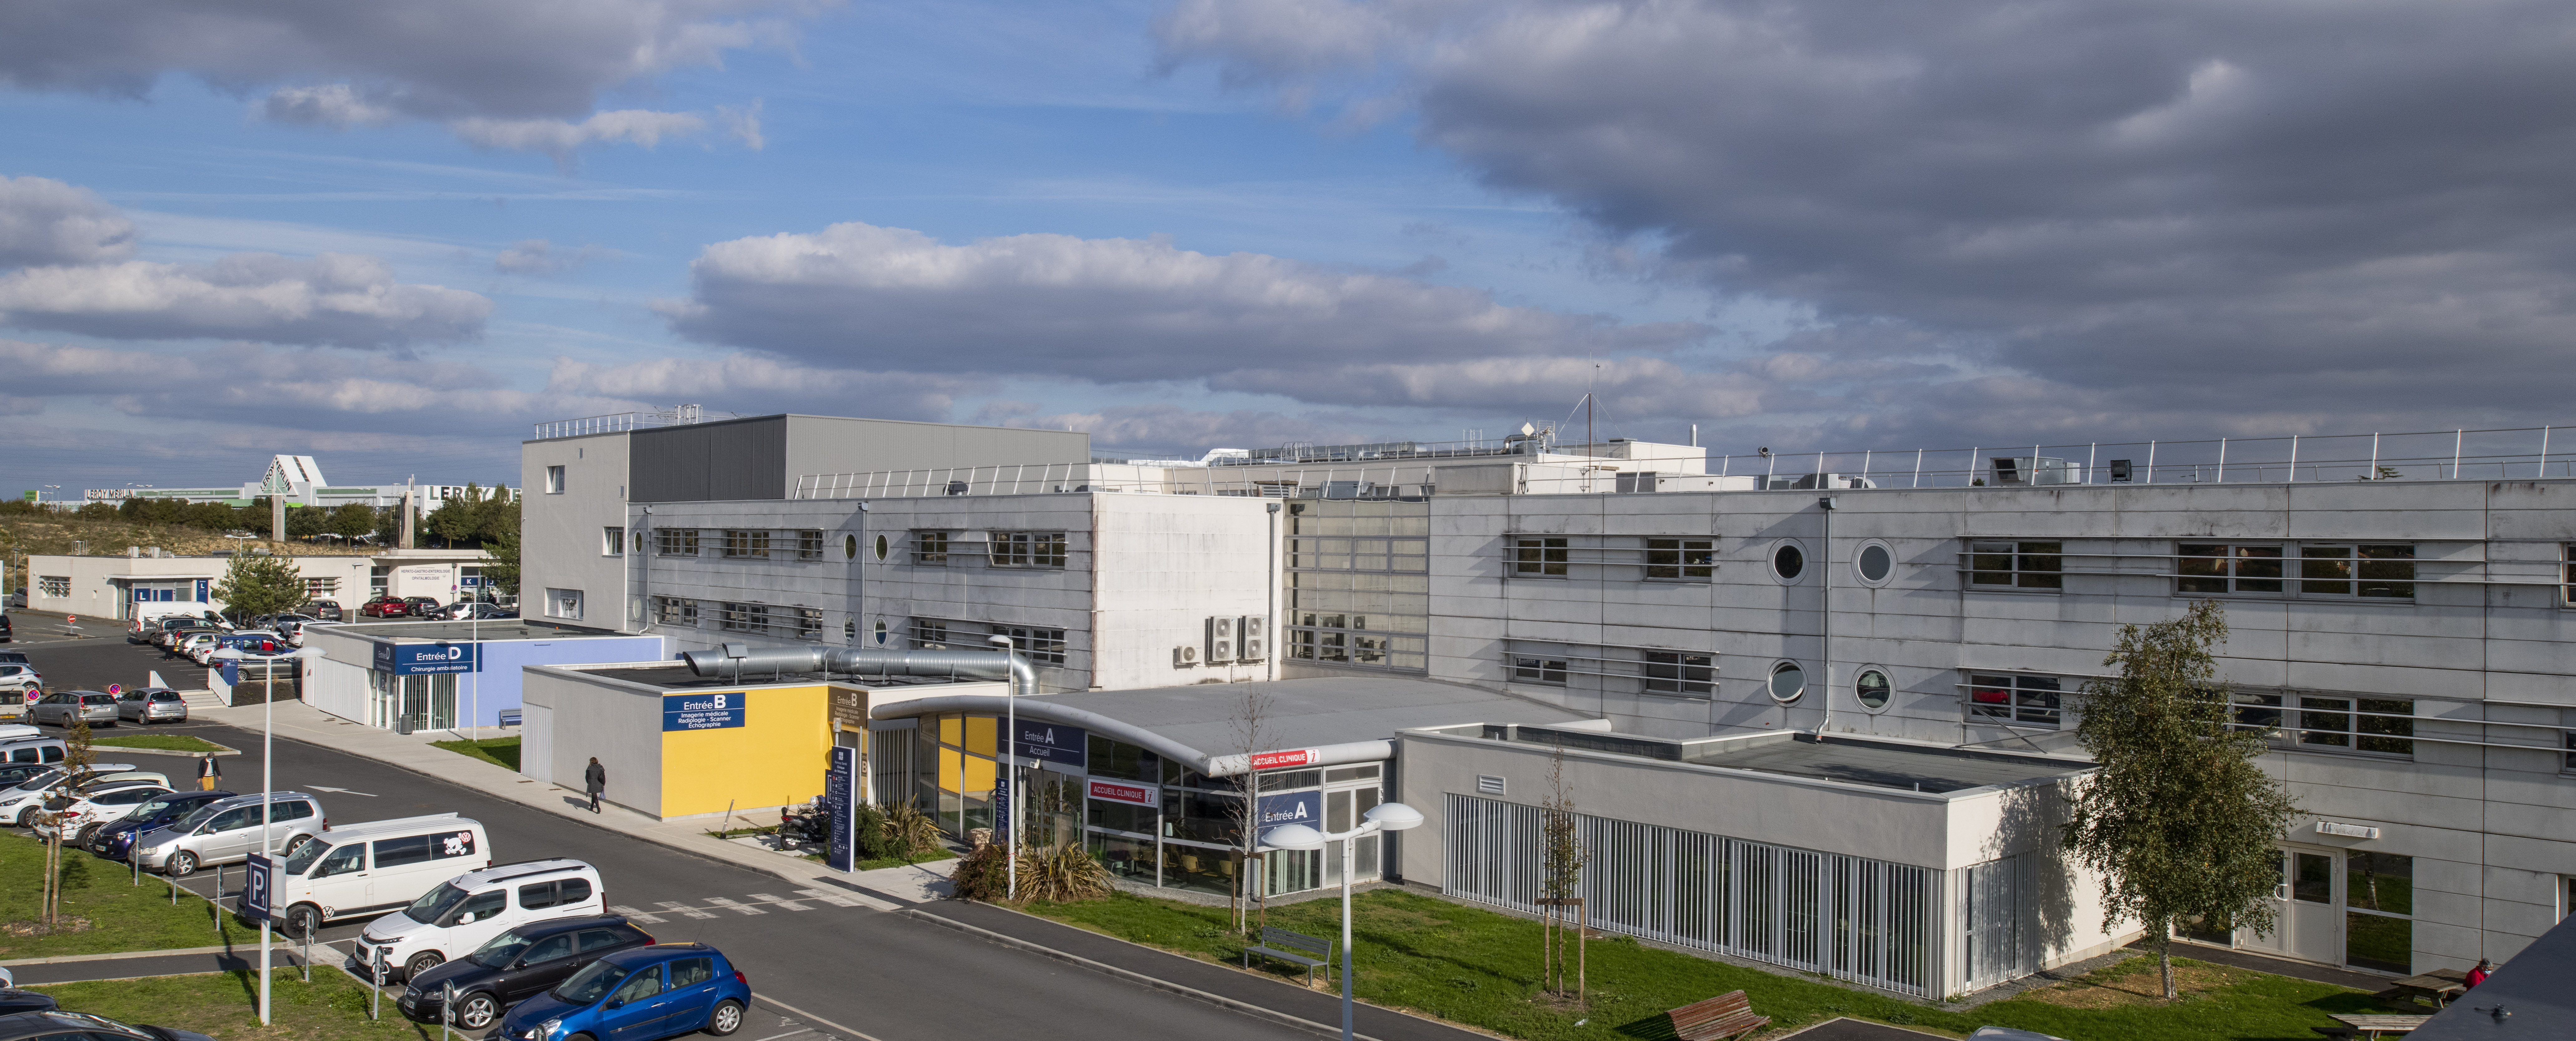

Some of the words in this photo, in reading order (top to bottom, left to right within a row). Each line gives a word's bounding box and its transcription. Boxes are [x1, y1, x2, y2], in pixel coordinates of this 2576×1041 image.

[87, 489, 107, 499] LEROY
[109, 489, 133, 499] MERLIN
[139, 592, 146, 600] L
[386, 647, 390, 660] D
[417, 652, 446, 660] Entrée
[448, 647, 461, 659] D
[684, 701, 713, 710] Entrée
[714, 695, 726, 708] B
[838, 696, 851, 705] Entrée
[852, 693, 857, 707] B
[1025, 731, 1044, 742] Entrée
[1045, 728, 1054, 744] A
[1029, 746, 1049, 756] Accueil
[1253, 756, 1278, 766] ACCUEIL
[1279, 754, 1306, 763] CLINIQUE
[862, 761, 867, 773] B
[1094, 786, 1116, 795] ACCUEIL
[1117, 789, 1142, 799] CLINIQUE
[1265, 810, 1293, 822] Entrée
[1294, 801, 1308, 819] A
[253, 870, 264, 900] P
[261, 894, 264, 906] 1
